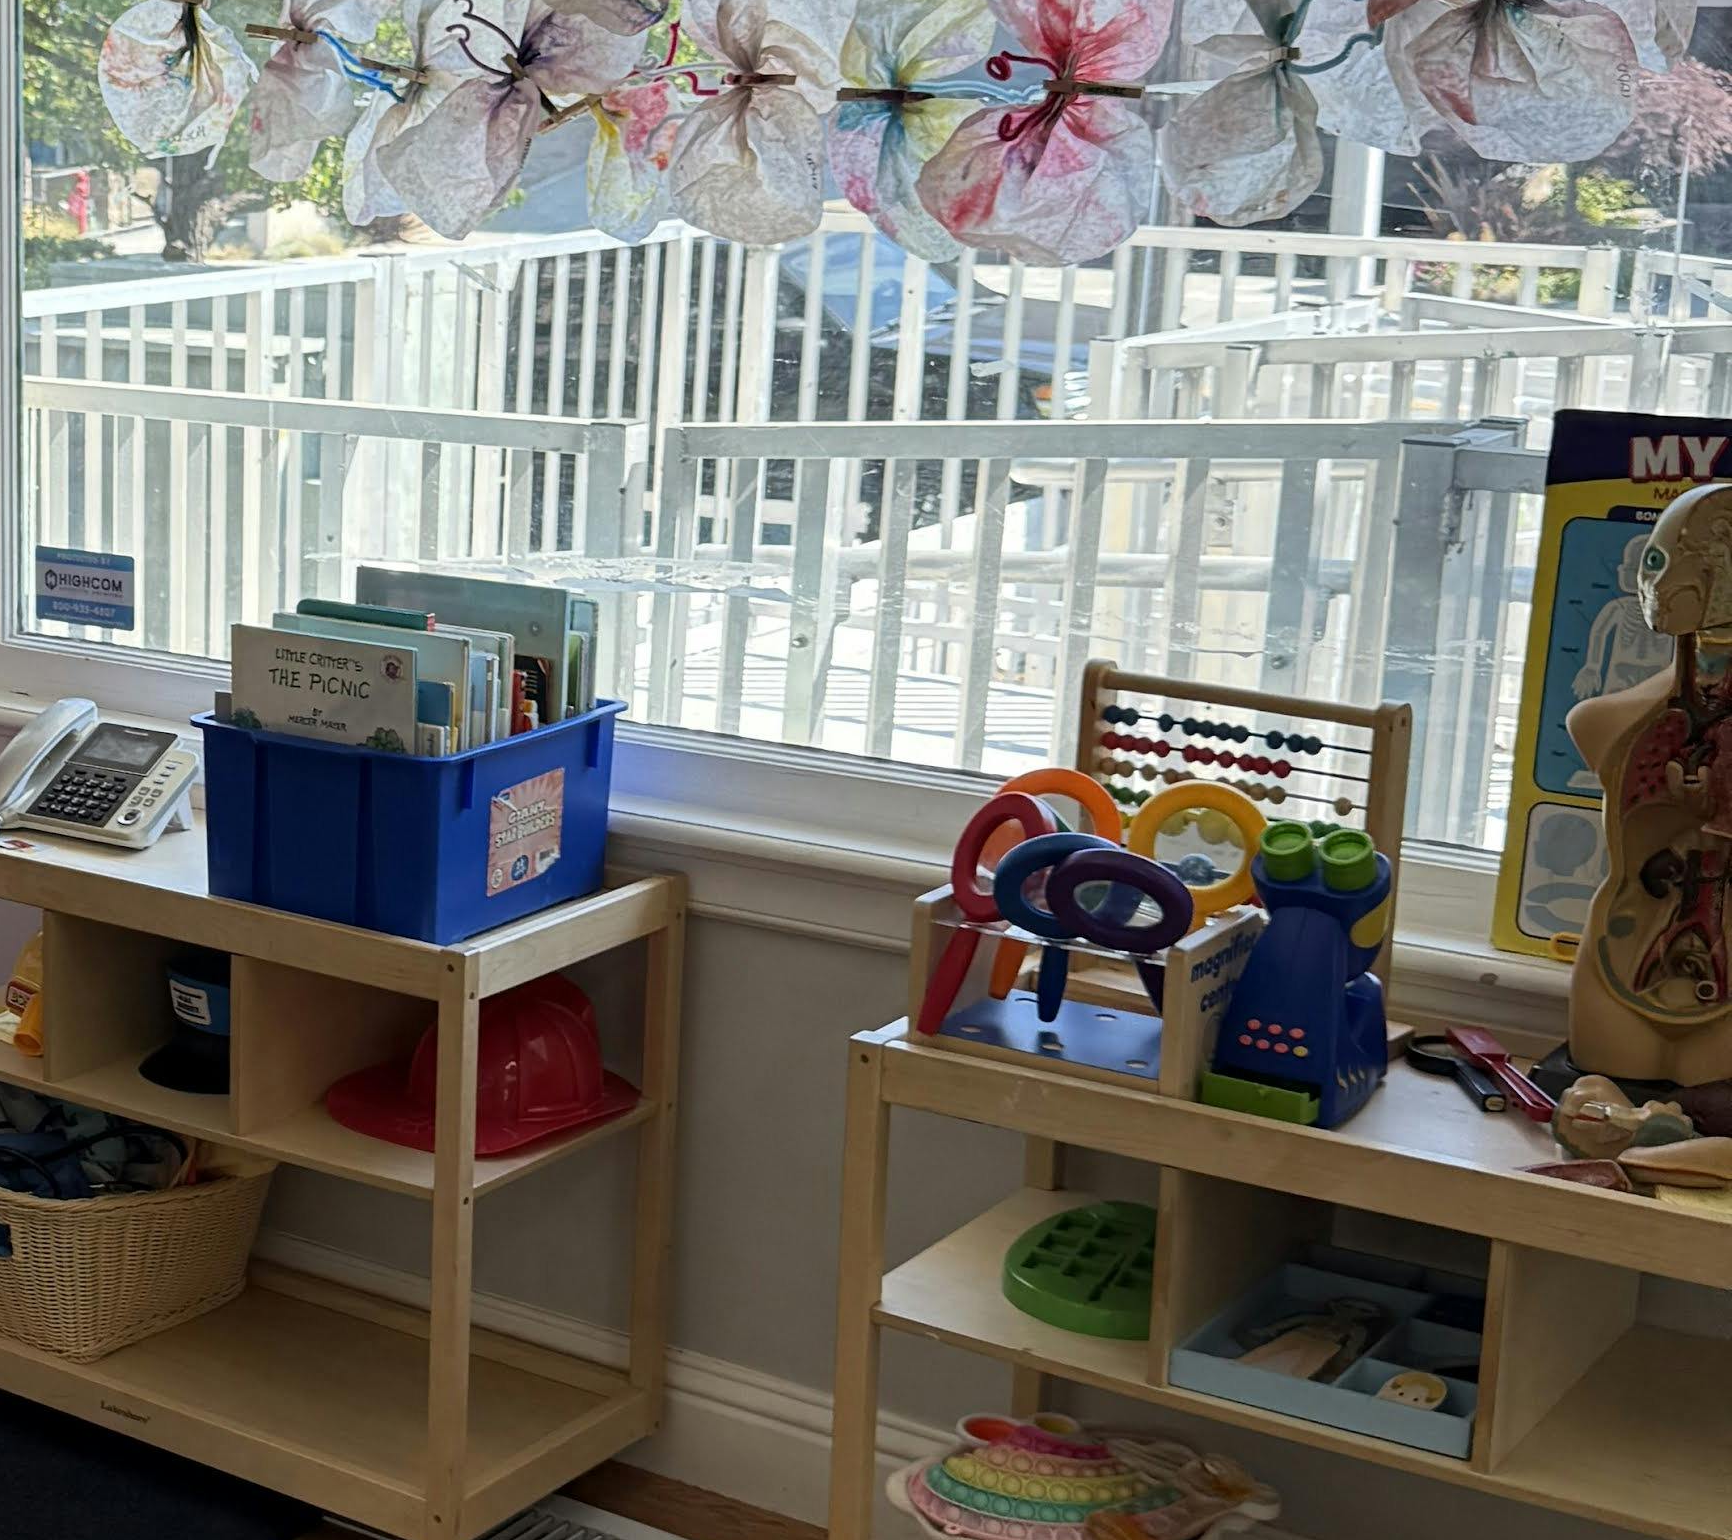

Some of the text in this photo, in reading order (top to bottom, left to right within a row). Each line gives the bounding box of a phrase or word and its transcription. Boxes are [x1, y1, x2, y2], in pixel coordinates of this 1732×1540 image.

[1631, 435, 1728, 482] MY
[59, 573, 123, 592] HIGHCOM
[275, 648, 305, 663] LITTLE
[269, 668, 301, 688] THE
